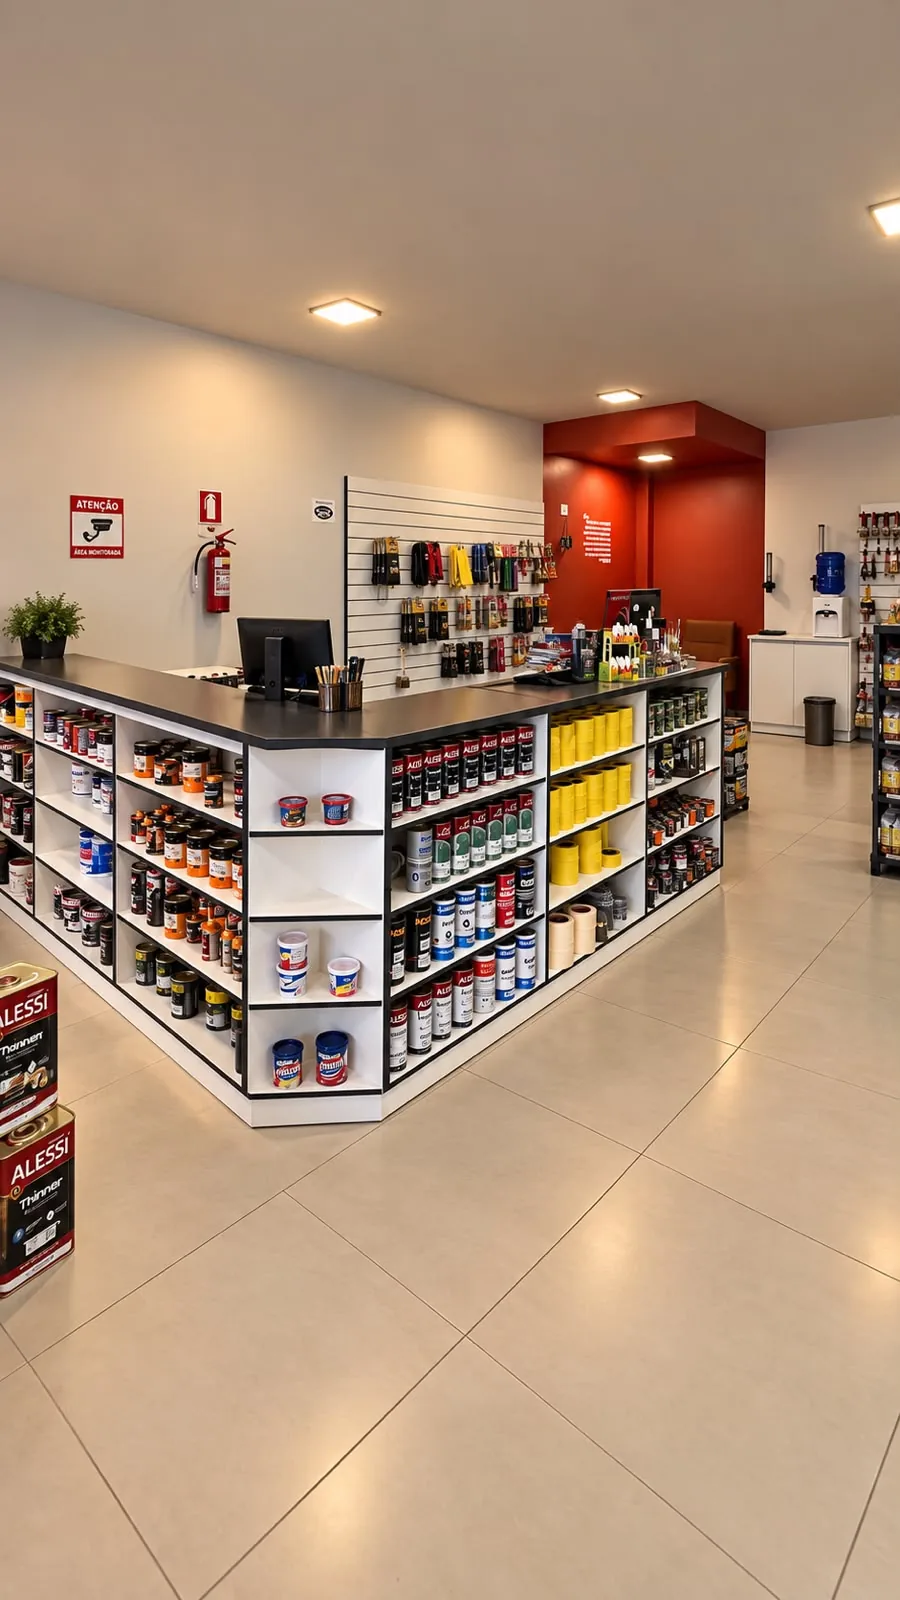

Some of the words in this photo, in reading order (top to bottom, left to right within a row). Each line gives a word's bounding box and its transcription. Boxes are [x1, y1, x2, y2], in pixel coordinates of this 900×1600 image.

[76, 499, 119, 512] ATENÇÃO
[11, 1135, 69, 1186] ALESSI
[19, 1177, 63, 1211] Thinner
